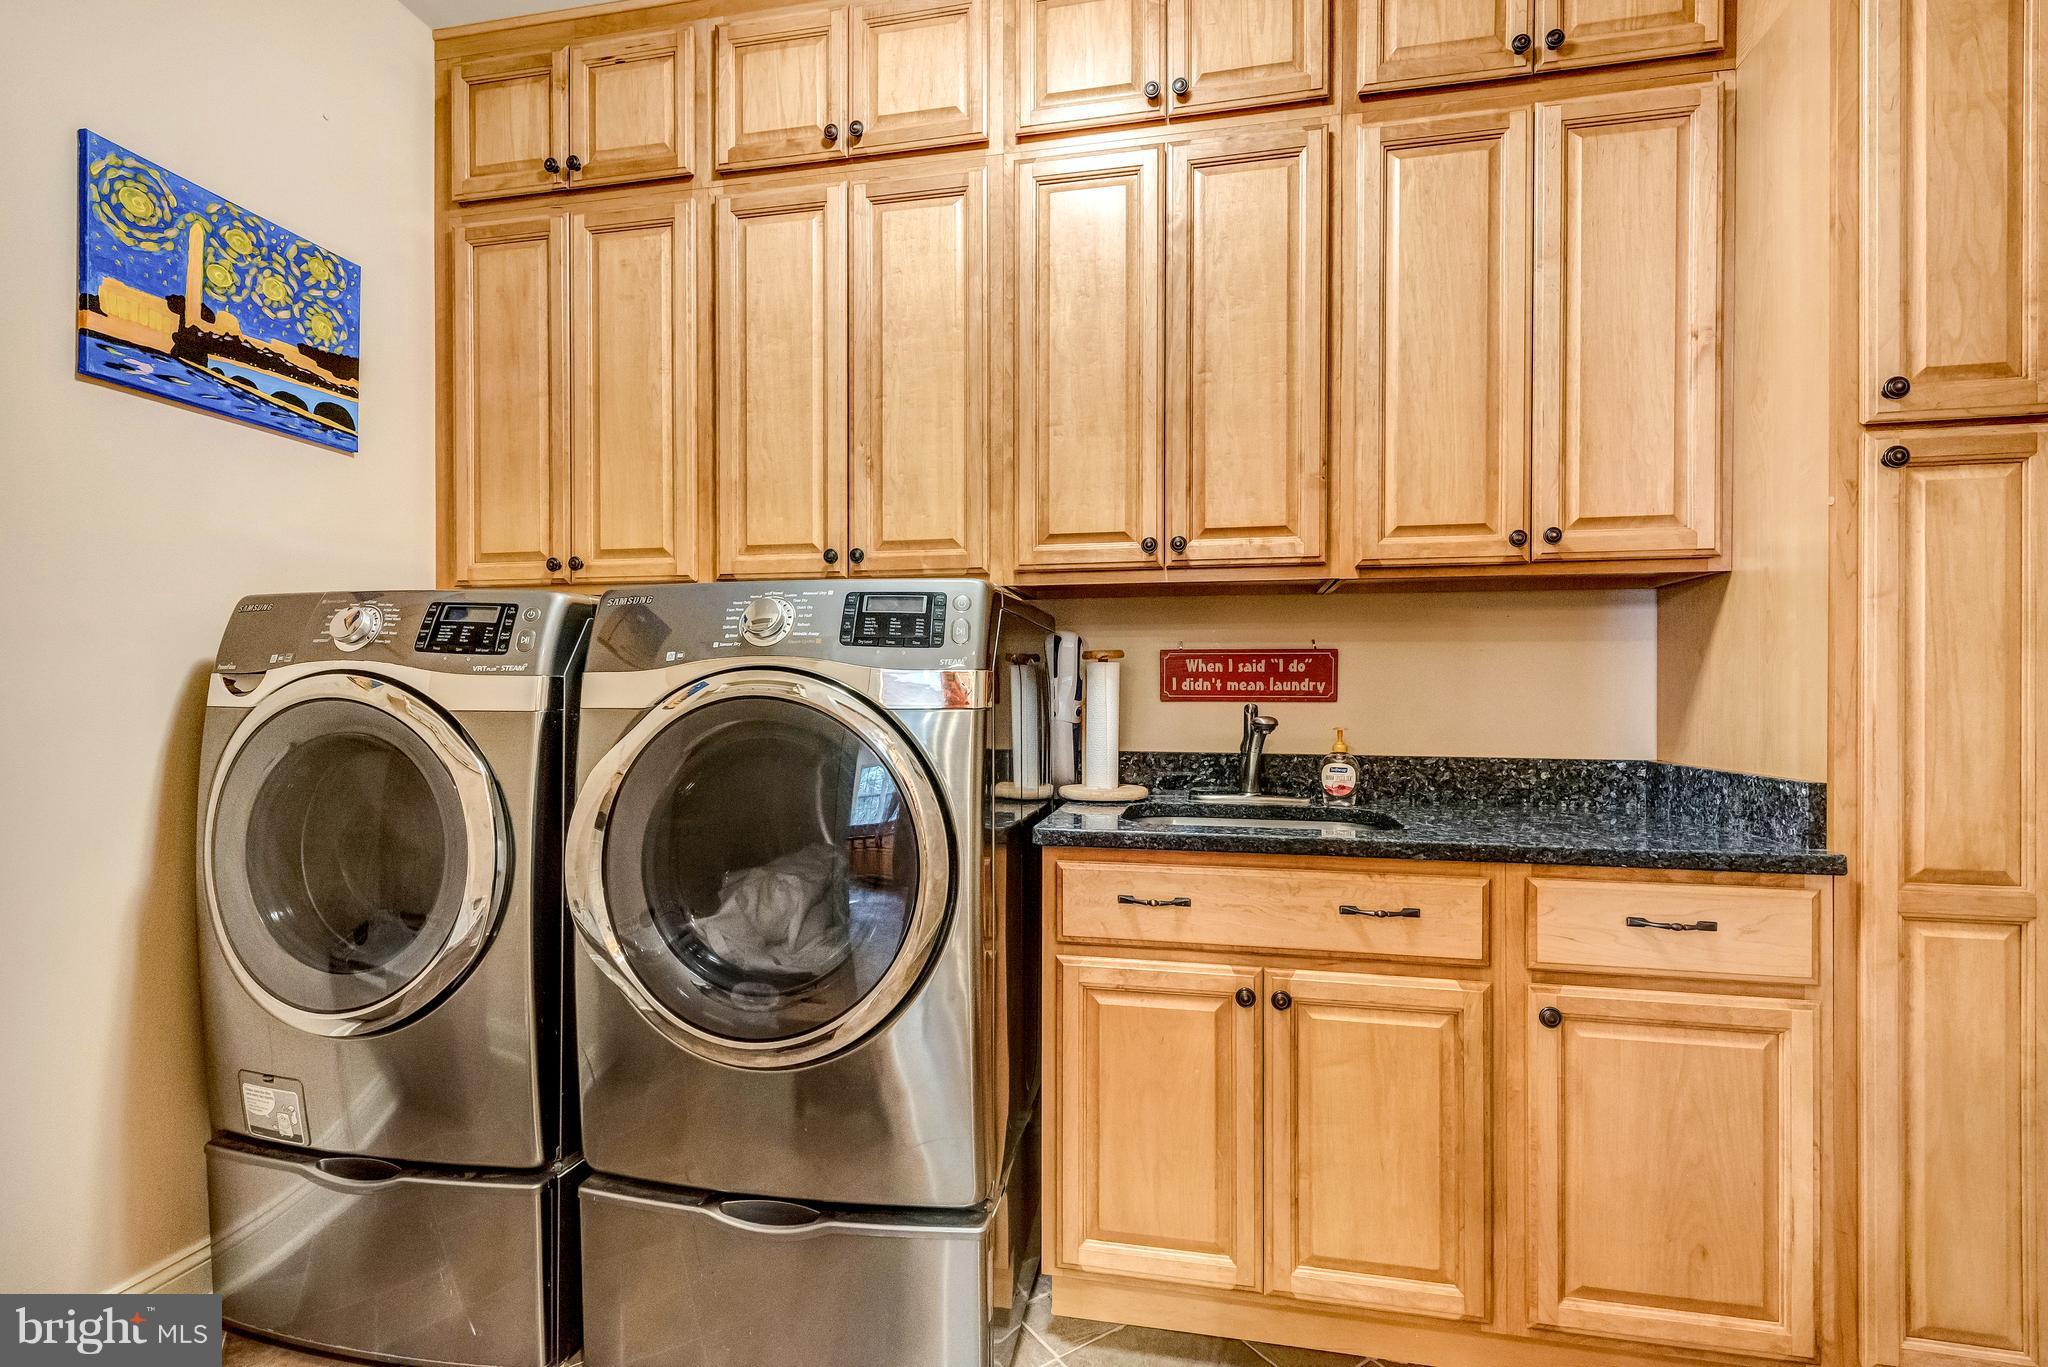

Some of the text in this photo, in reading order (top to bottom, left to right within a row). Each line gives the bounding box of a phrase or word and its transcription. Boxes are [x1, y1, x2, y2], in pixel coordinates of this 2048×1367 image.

[607, 595, 654, 606] SAMSUNG
[238, 603, 274, 613] SAMSUNG
[1186, 658, 1223, 673] When
[1228, 659, 1233, 673] I
[1238, 659, 1266, 673] said
[1172, 677, 1326, 693] I didn't mean laundry
